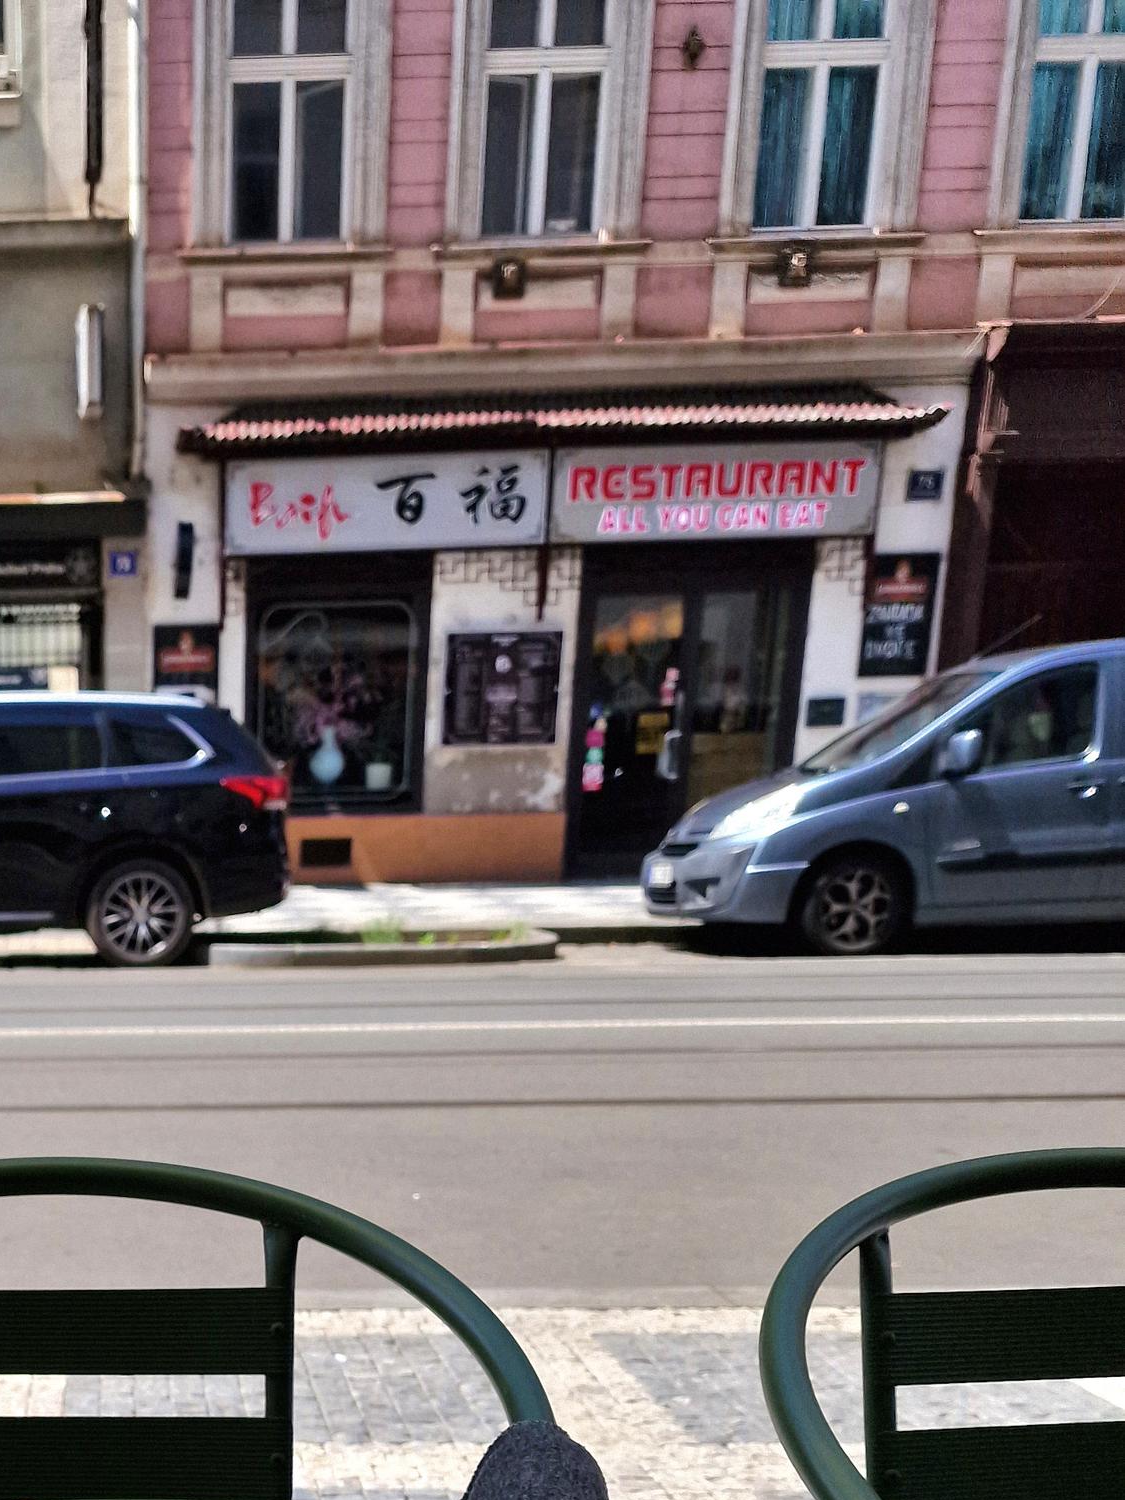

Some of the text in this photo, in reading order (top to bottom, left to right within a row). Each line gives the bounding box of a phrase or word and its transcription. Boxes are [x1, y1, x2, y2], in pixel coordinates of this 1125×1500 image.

[567, 457, 866, 502] RESTAURANT
[597, 502, 831, 535] ALL YOU CAN EAT
